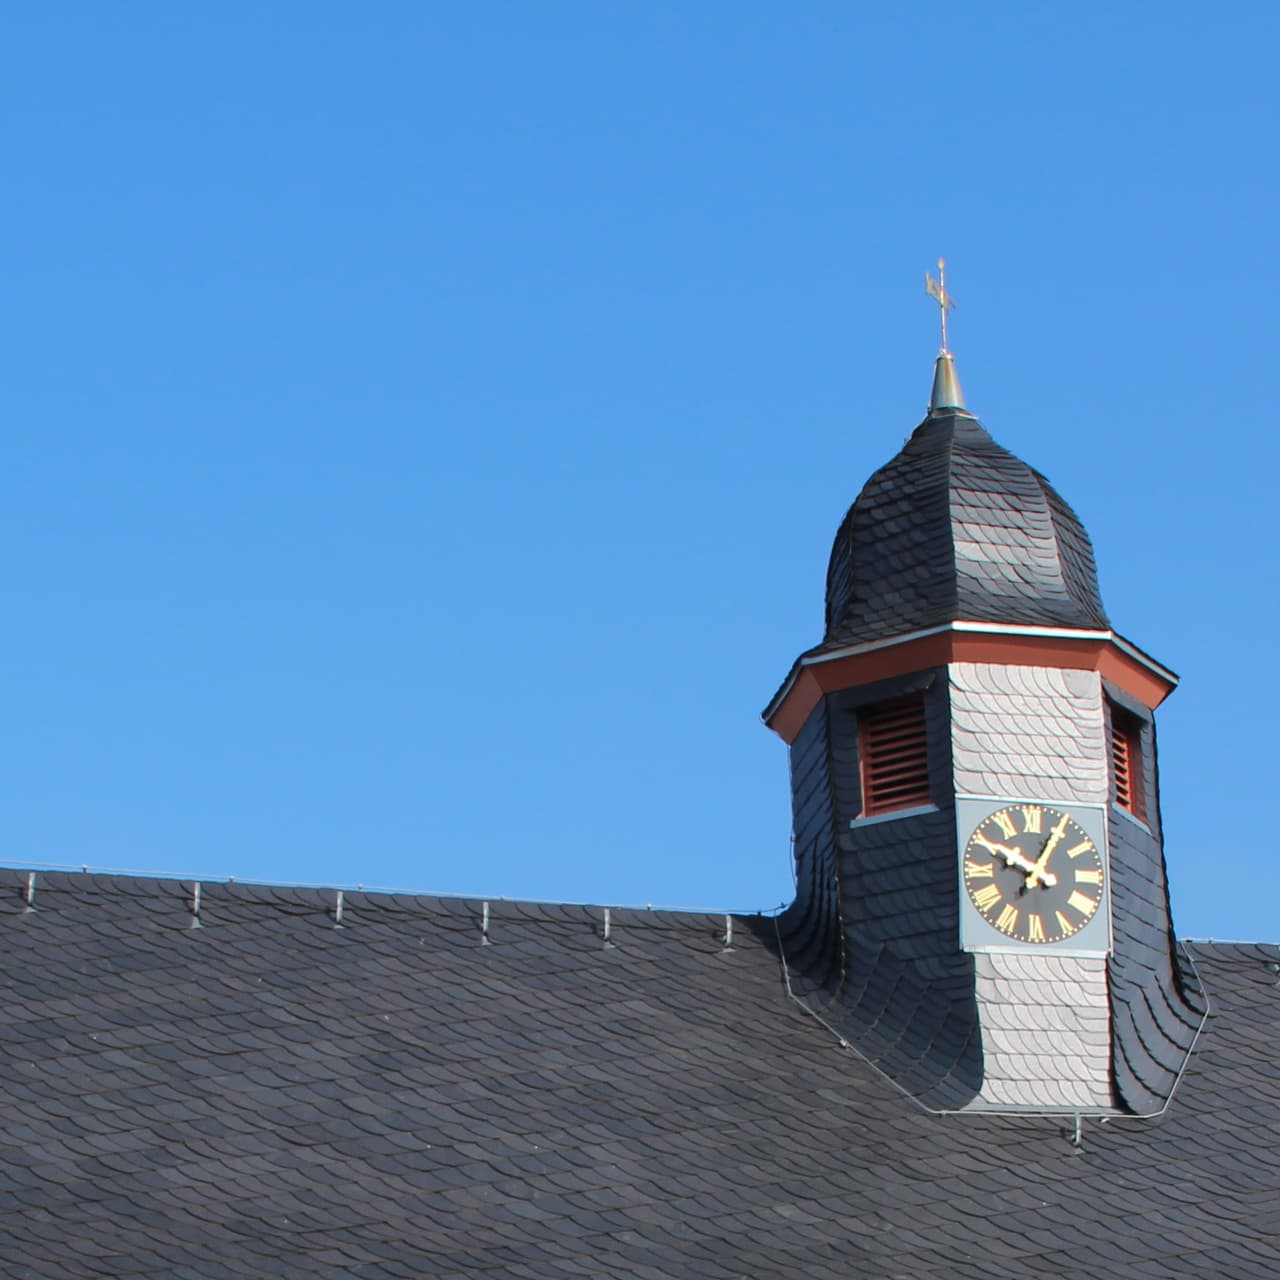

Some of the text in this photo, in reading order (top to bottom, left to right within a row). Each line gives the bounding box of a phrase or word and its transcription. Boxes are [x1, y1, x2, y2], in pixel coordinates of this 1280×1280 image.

[992, 813, 1018, 840] XI
[1022, 808, 1041, 833] XII
[1066, 840, 1091, 858] II
[968, 861, 993, 878] IX
[1029, 914, 1045, 939] VI
[1055, 910, 1074, 934] V
